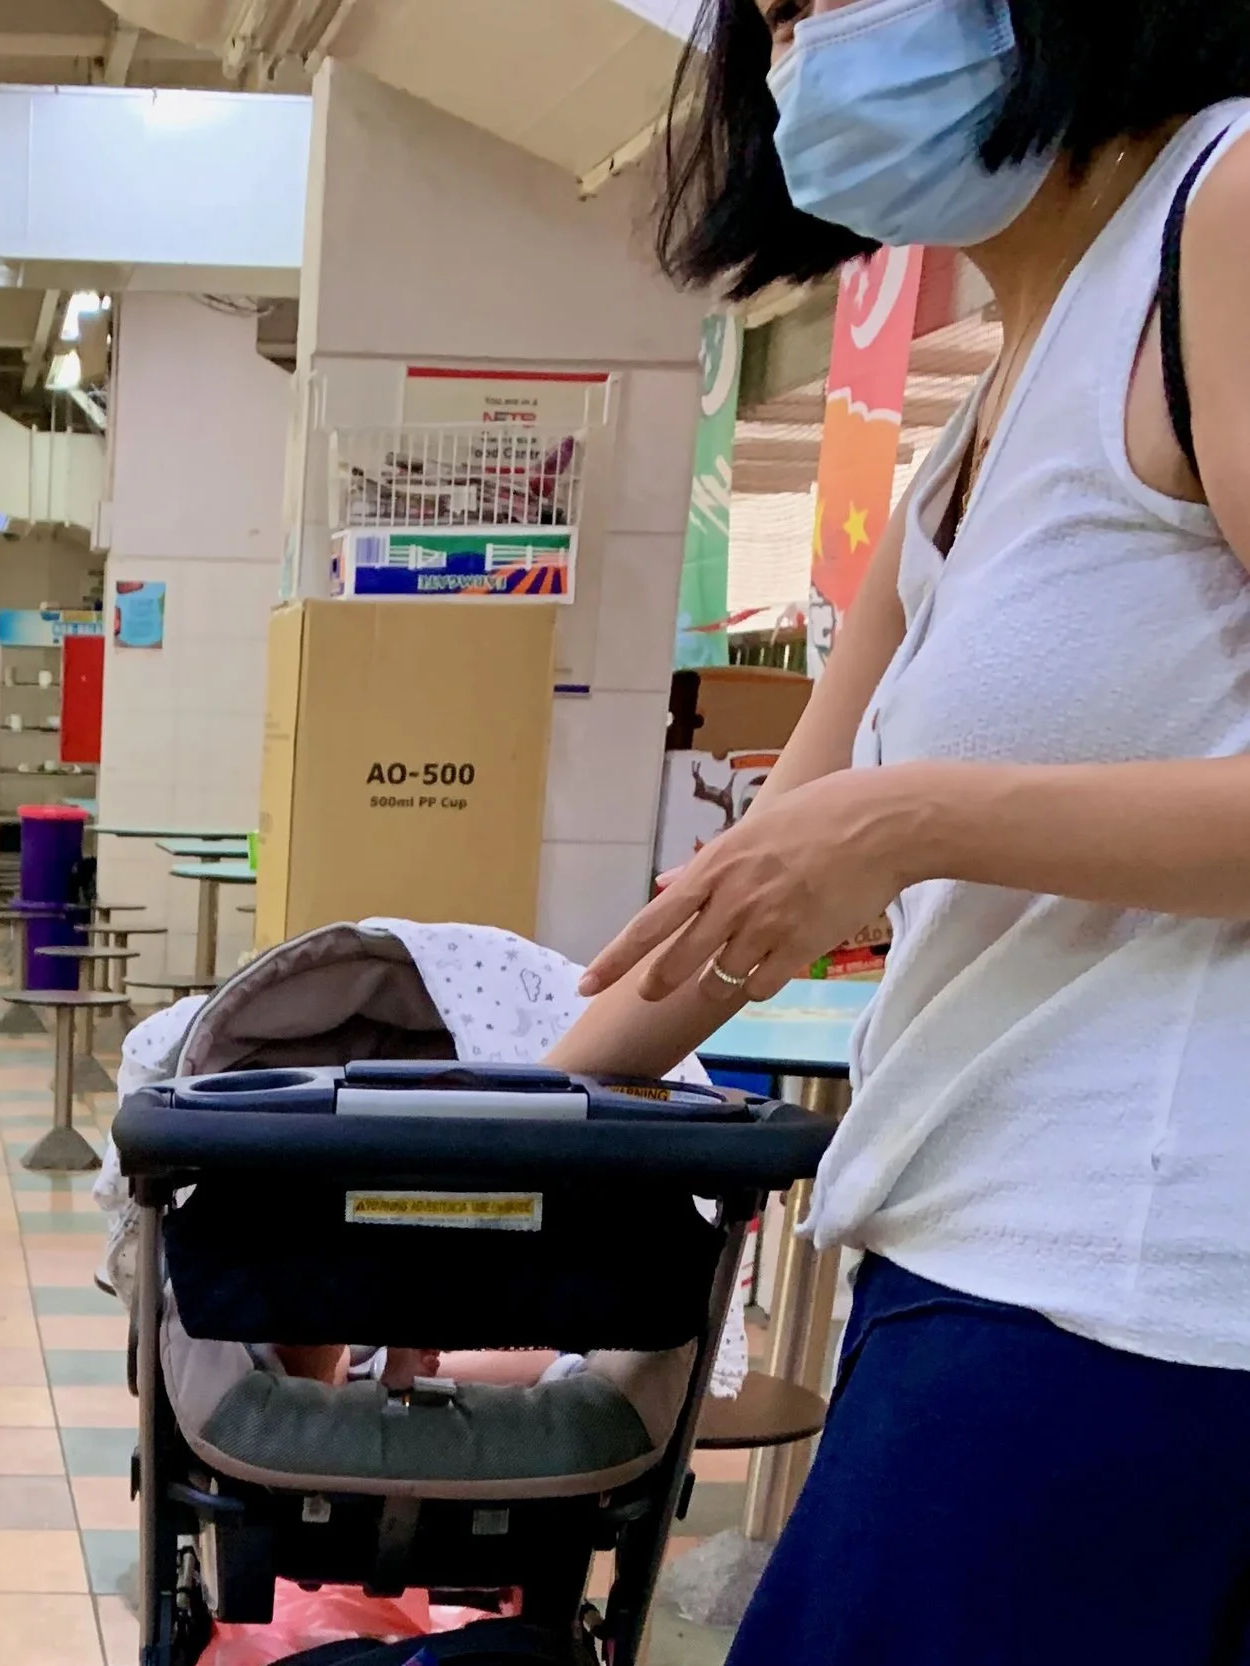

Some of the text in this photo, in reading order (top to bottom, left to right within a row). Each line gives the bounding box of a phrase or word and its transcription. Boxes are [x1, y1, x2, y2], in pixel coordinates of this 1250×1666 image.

[366, 762, 475, 786] AO-500
[370, 796, 467, 810] 500ml PP Cup
